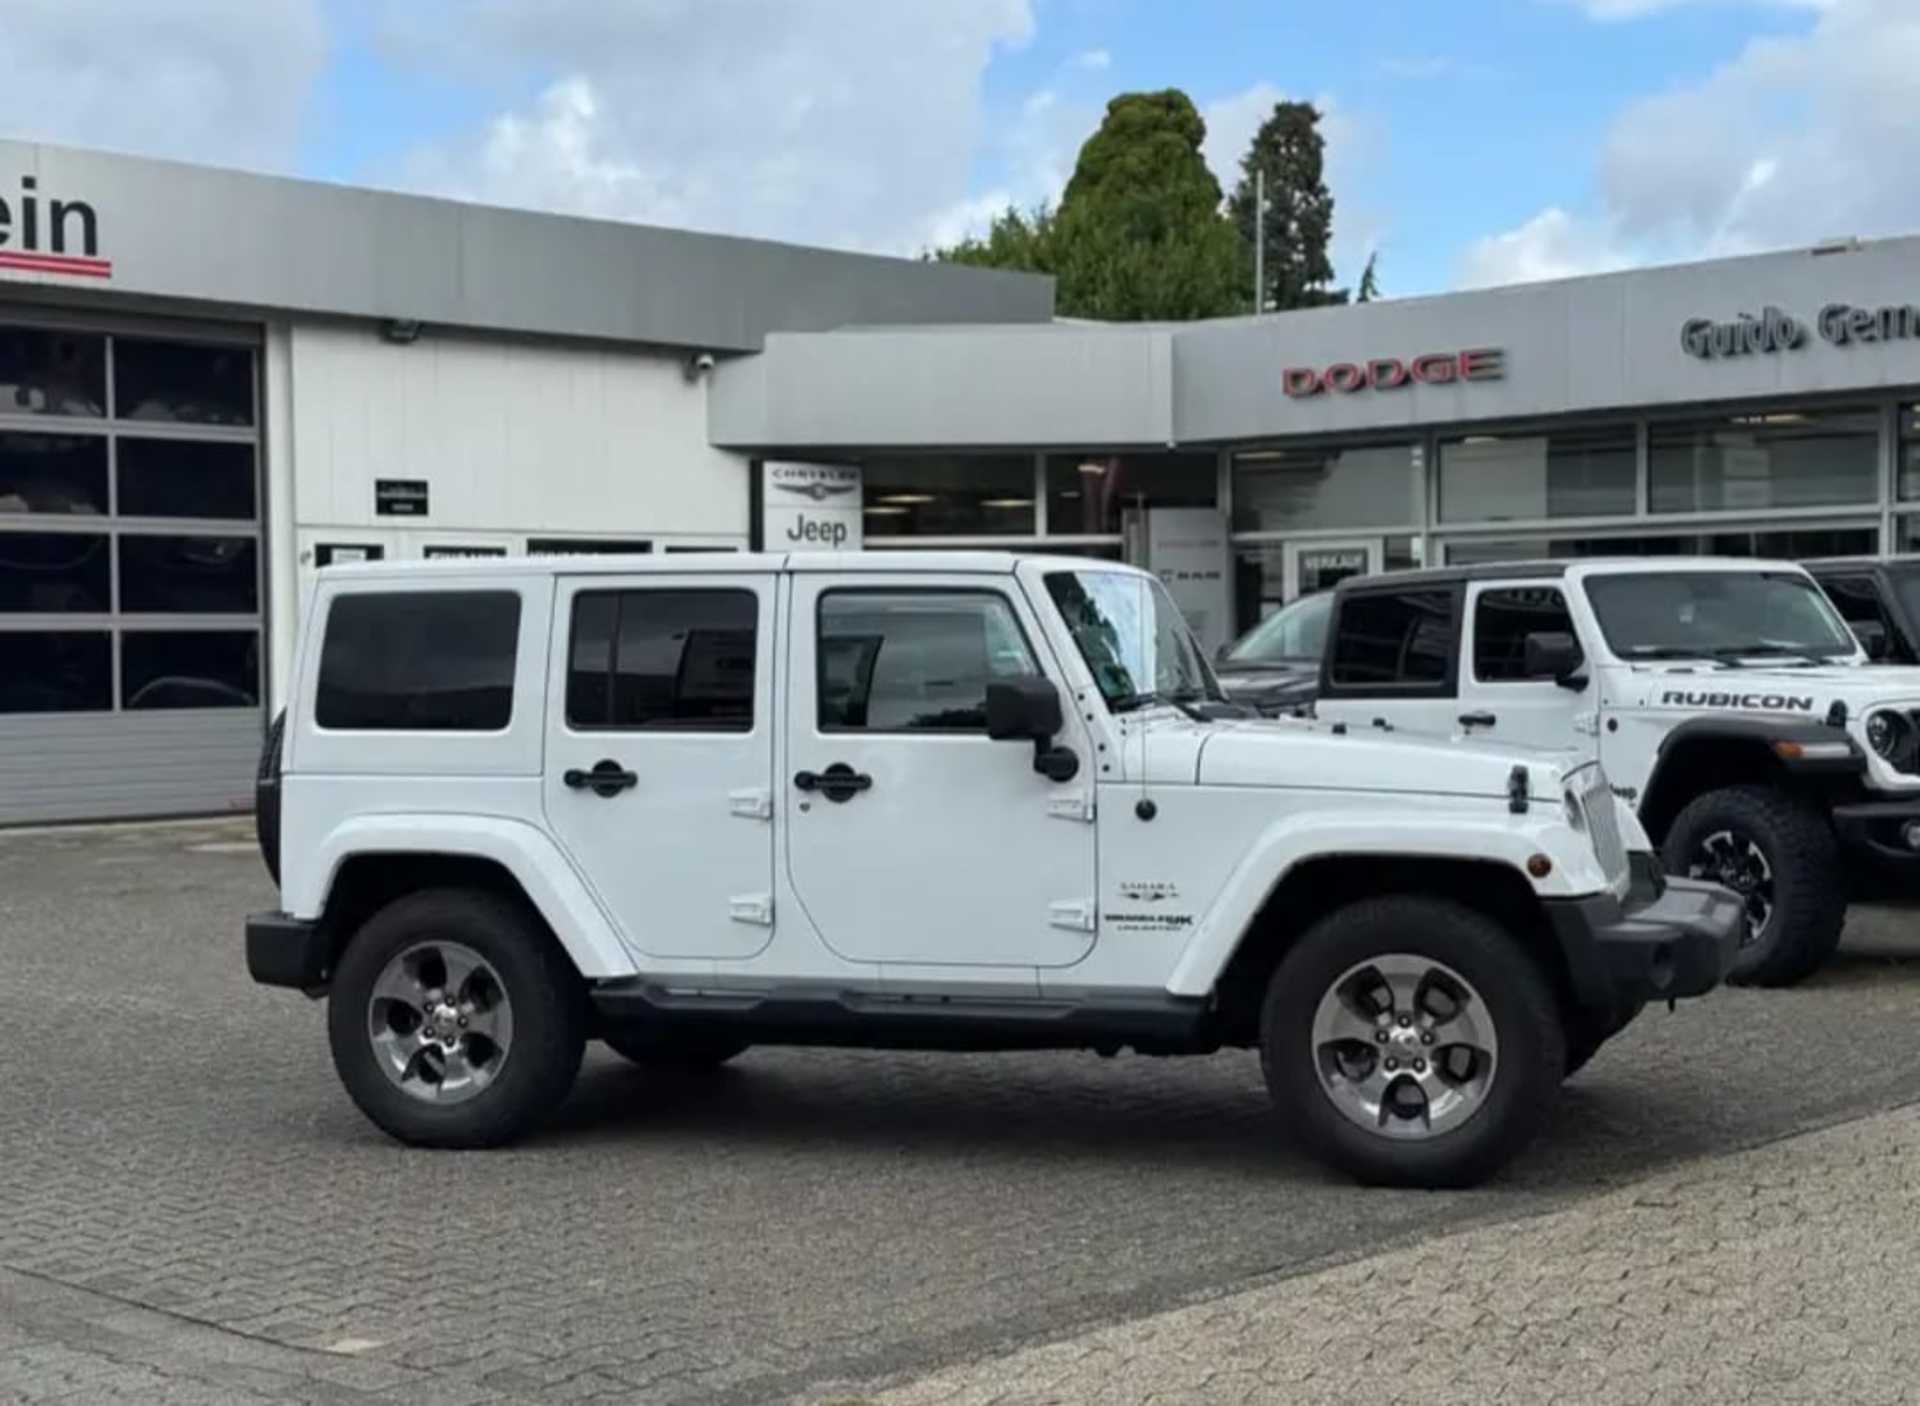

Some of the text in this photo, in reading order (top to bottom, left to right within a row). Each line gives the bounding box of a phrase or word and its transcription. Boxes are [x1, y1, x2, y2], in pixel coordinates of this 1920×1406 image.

[0, 175, 98, 257] in
[1681, 306, 1808, 358] Guido
[1282, 347, 1506, 399] DODGE
[771, 468, 857, 481] CHRYSLER
[786, 513, 848, 549] Jeep
[1662, 690, 1814, 712] RUBICON
